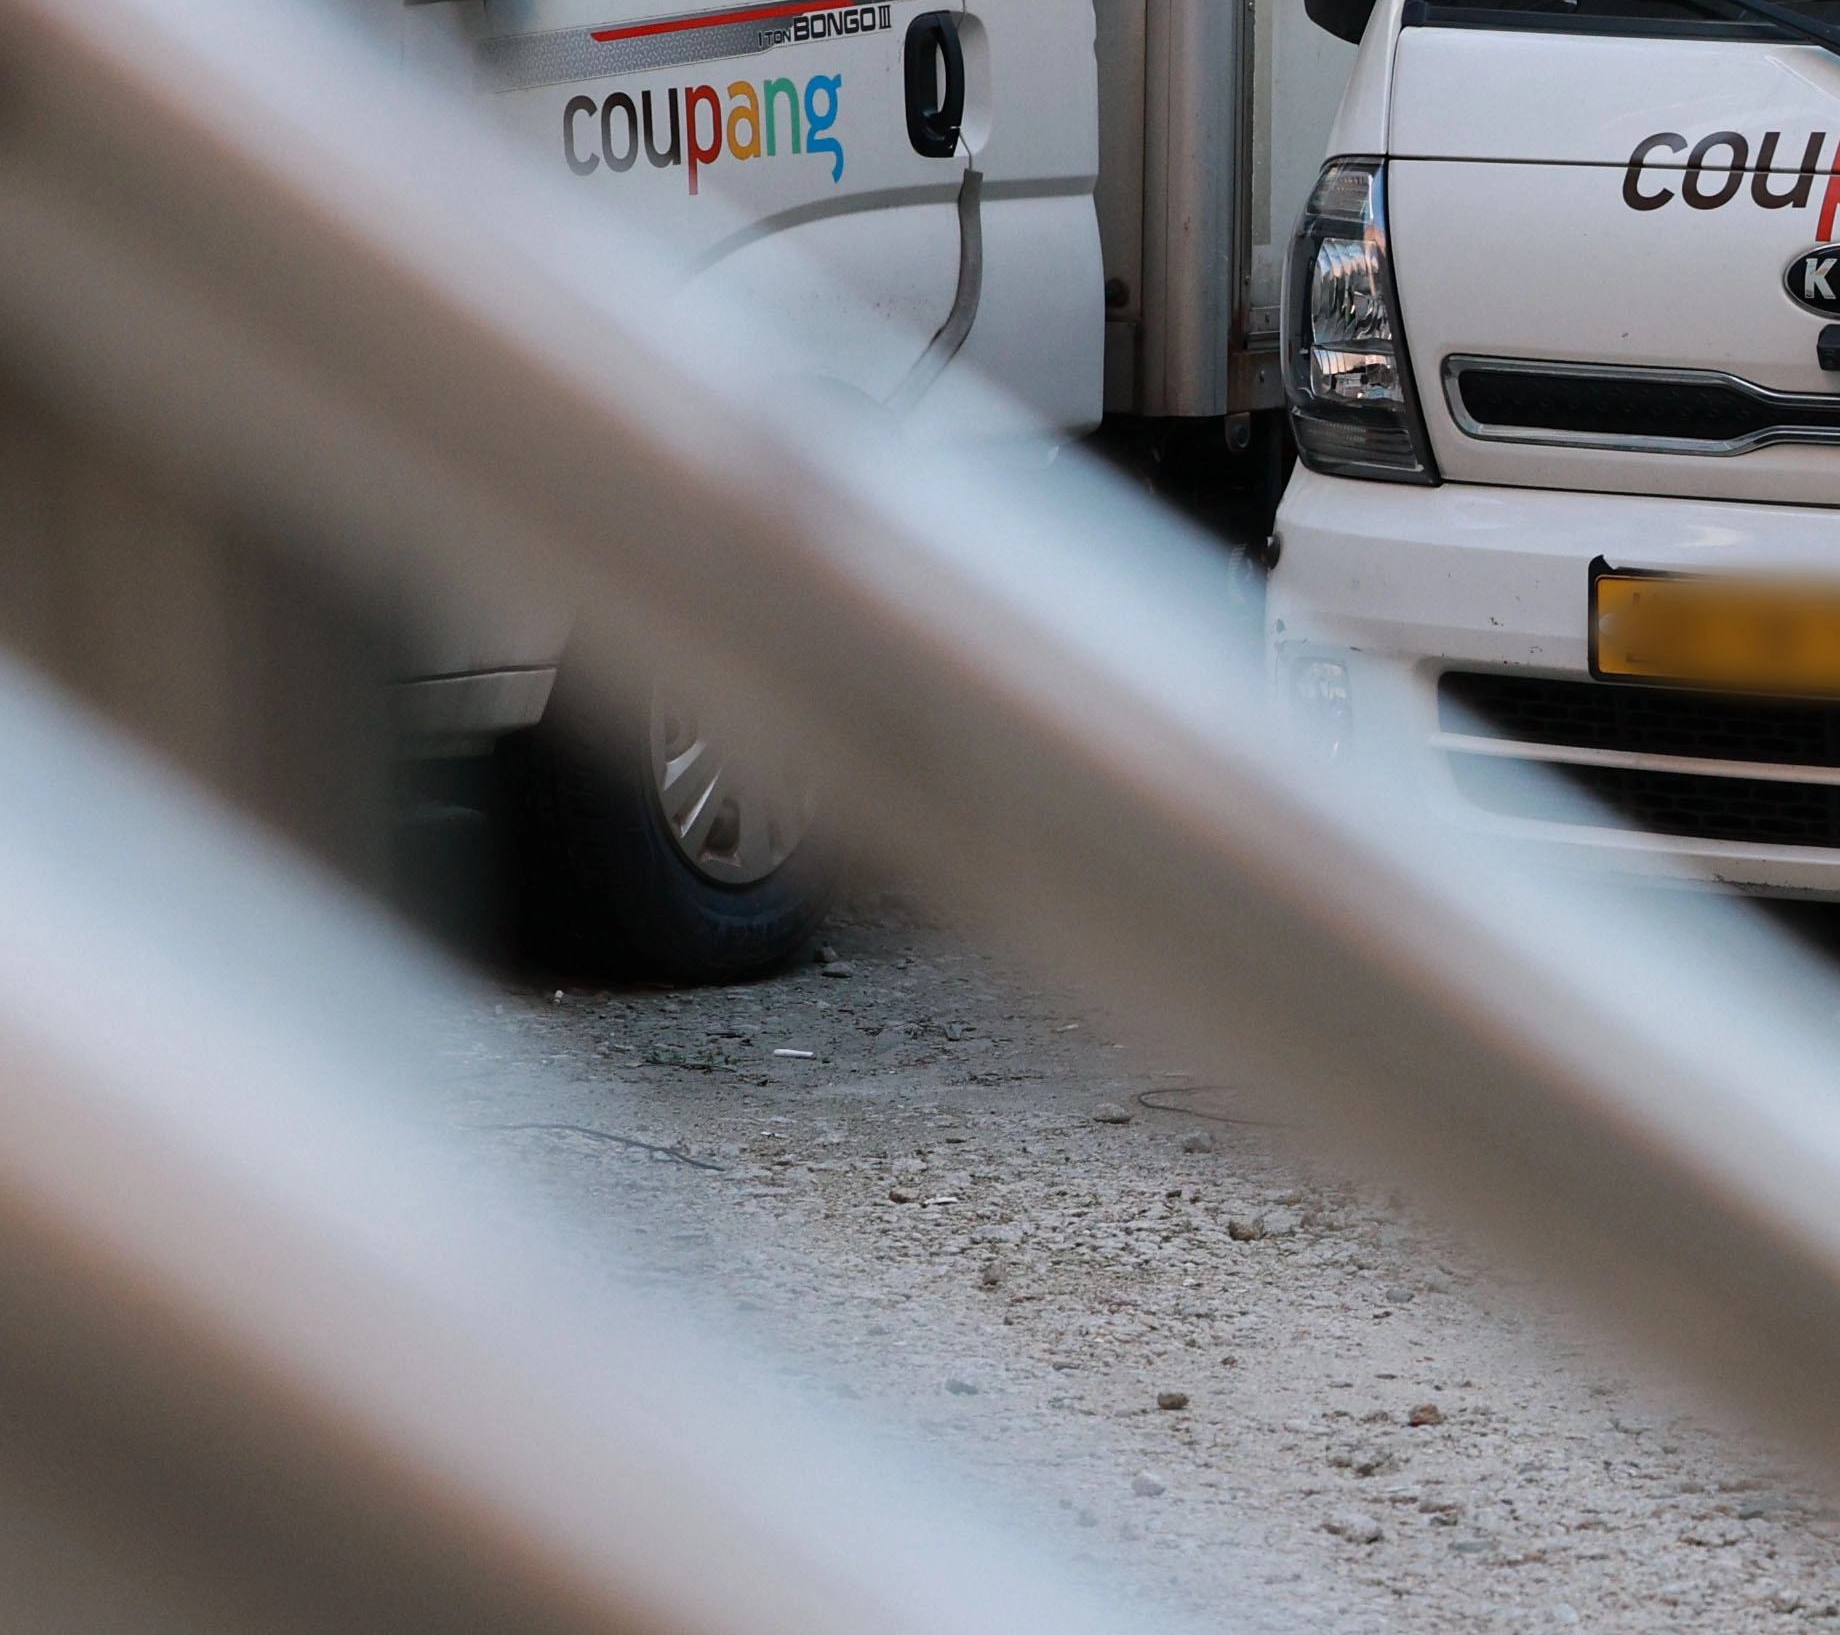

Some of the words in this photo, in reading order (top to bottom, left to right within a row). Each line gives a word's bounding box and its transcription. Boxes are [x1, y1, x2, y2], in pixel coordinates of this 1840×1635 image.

[764, 29, 792, 45] TON
[793, 6, 876, 41] BONGO
[563, 73, 844, 195] coupang
